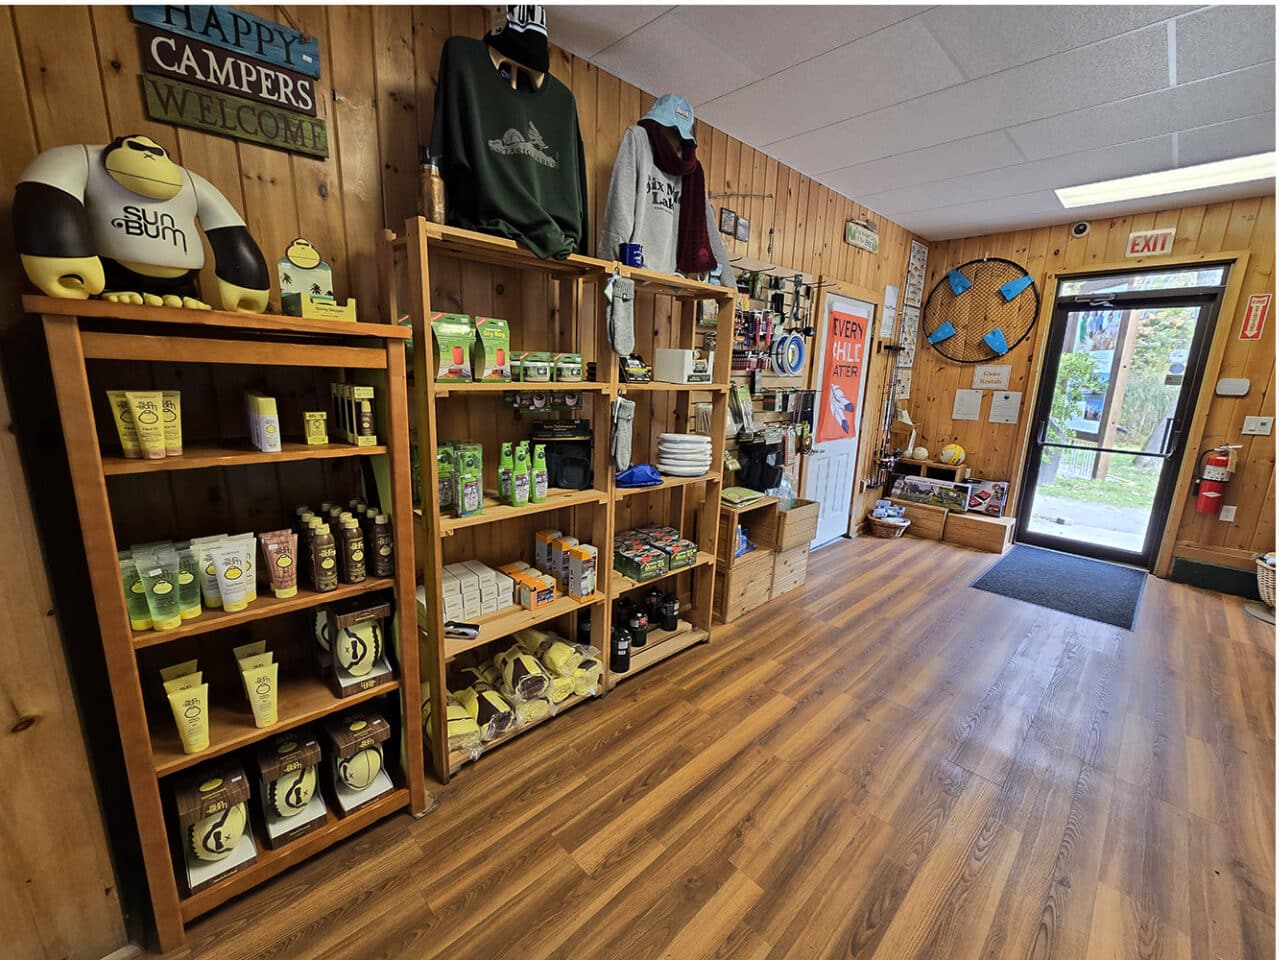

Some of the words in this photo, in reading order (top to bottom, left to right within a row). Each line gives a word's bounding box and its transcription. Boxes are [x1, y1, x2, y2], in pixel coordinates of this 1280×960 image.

[163, 5, 299, 65] HAPPY
[151, 36, 313, 111] CAMPERS
[151, 79, 326, 152] WELCOME
[1129, 231, 1173, 254] EXIT
[832, 317, 864, 340] EVERY
